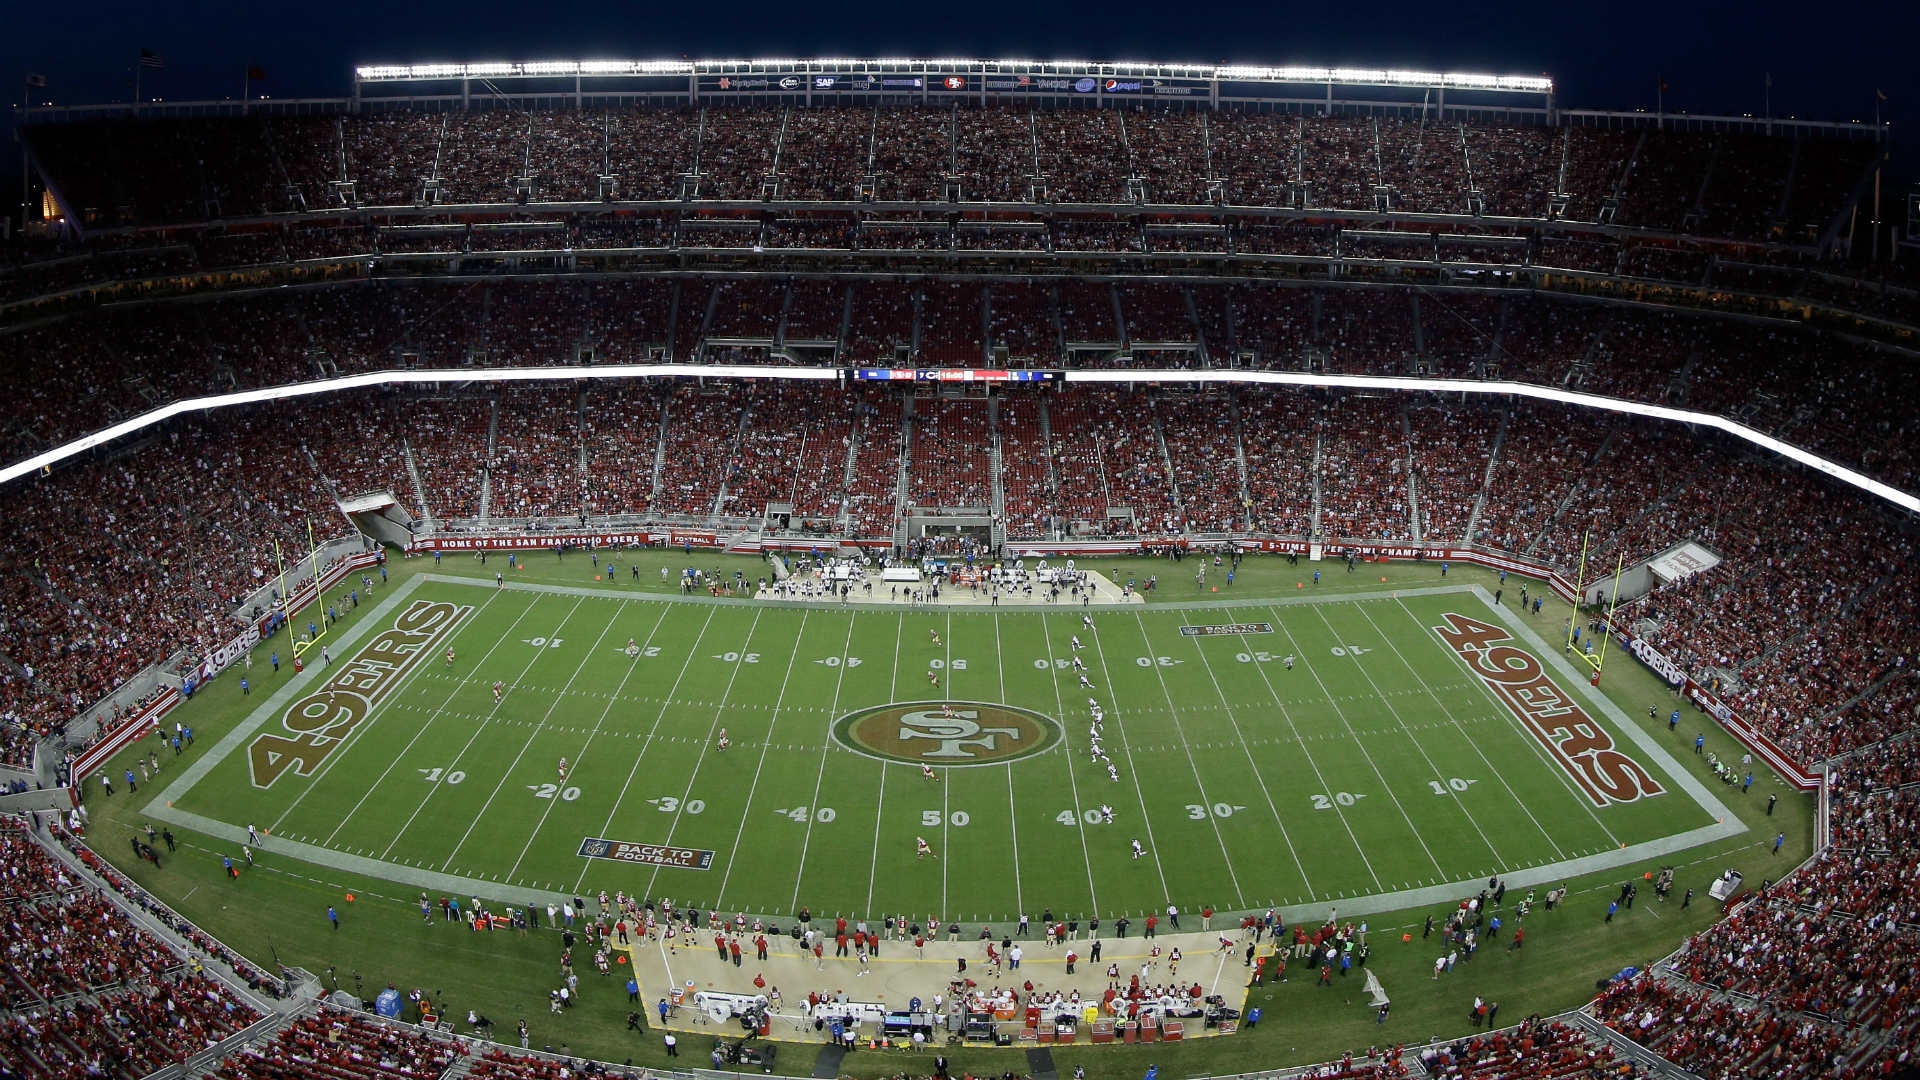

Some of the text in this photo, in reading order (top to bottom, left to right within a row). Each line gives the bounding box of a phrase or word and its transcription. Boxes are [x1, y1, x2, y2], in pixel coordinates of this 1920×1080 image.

[816, 78, 834, 87] SAP
[442, 540, 468, 548] HOME
[475, 539, 489, 547] OF
[492, 539, 514, 547] THE
[540, 536, 602, 546] FRANCISO
[606, 535, 639, 543] 49ERS
[1269, 542, 1306, 551] 5-TIME
[1381, 548, 1445, 558] CHAMPONS
[248, 600, 475, 789] 49ERS
[1432, 613, 1668, 808] 49ERS
[614, 852, 690, 866] FOOTBALL
[617, 844, 694, 859] BACK TO
